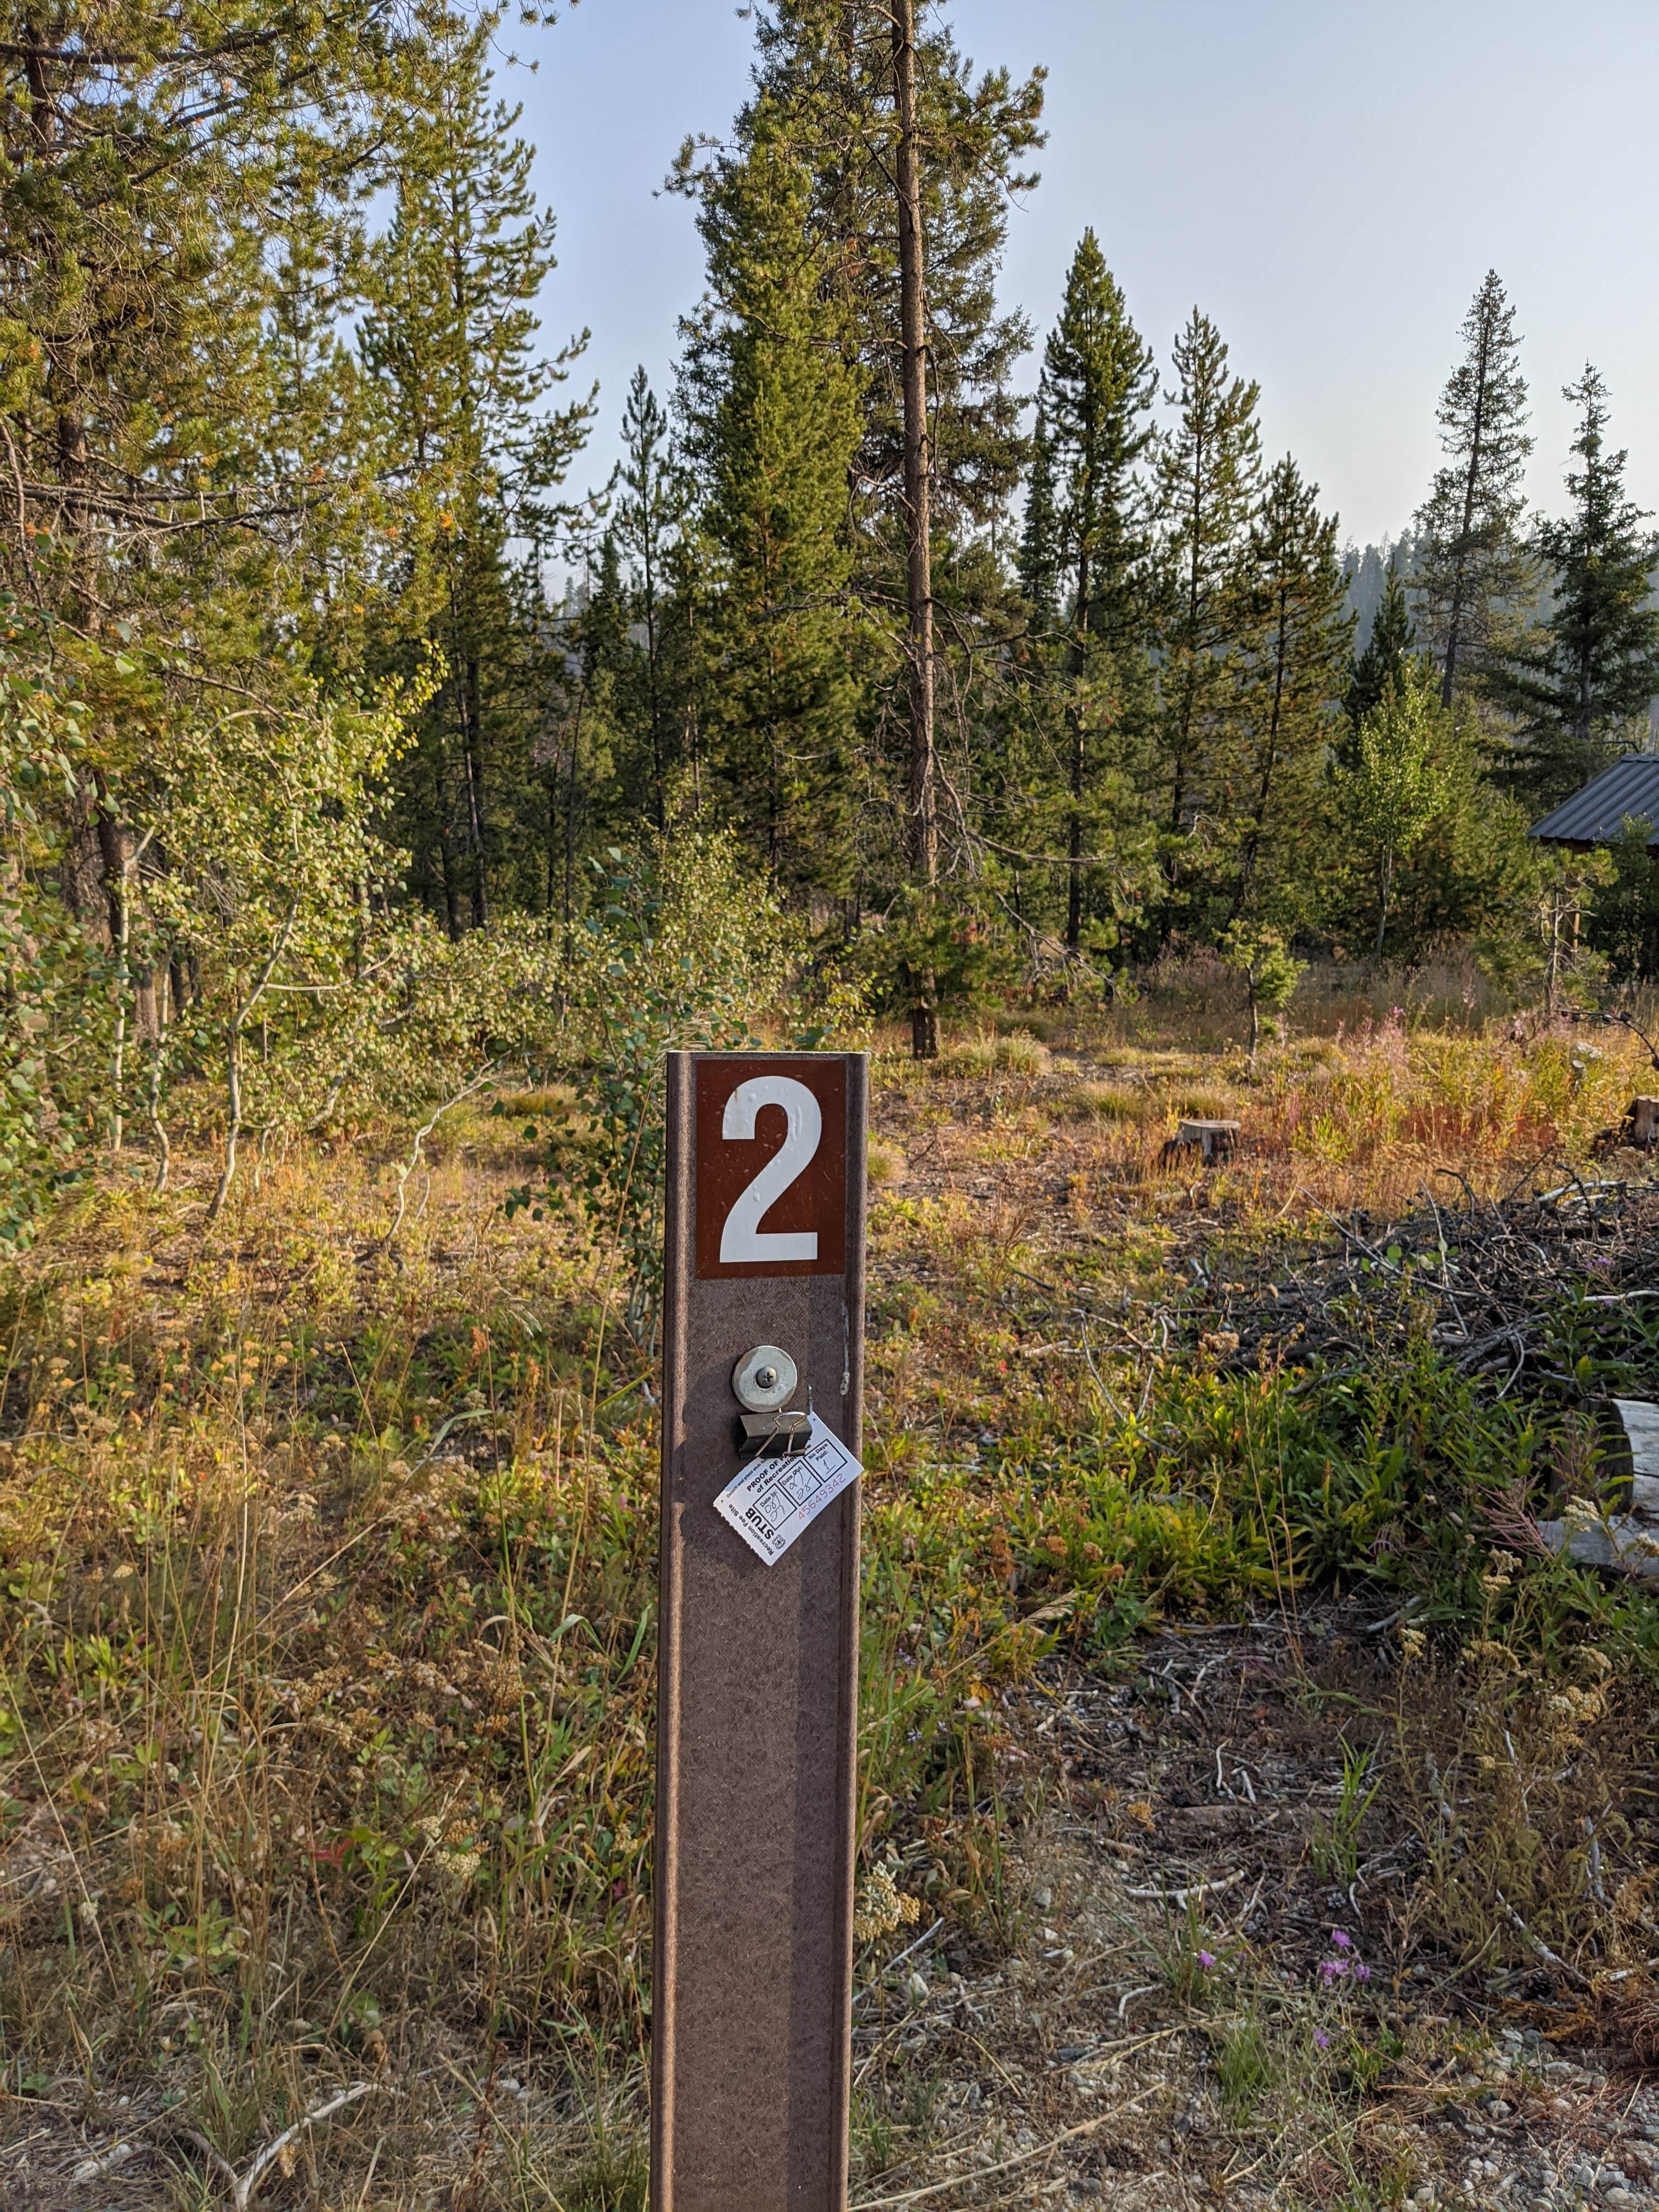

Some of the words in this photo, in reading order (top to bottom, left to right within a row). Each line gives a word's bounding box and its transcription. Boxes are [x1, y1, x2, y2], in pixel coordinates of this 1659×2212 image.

[720, 1076, 822, 1262] 2
[815, 1443, 828, 1453] Days
[815, 1451, 828, 1462] Paid:
[747, 1469, 768, 1492] PROOF
[769, 1460, 778, 1469] OF
[782, 1475, 793, 1486] Date
[726, 1486, 738, 1498] Detach
[744, 1470, 753, 1481] place
[757, 1484, 764, 1492] of
[760, 1497, 771, 1507] Date
[798, 1474, 846, 1520] 45649342
[729, 1504, 739, 1516] Site
[738, 1515, 748, 1527] Fee
[746, 1508, 774, 1539] STUB
[748, 1525, 774, 1555] Recreation
